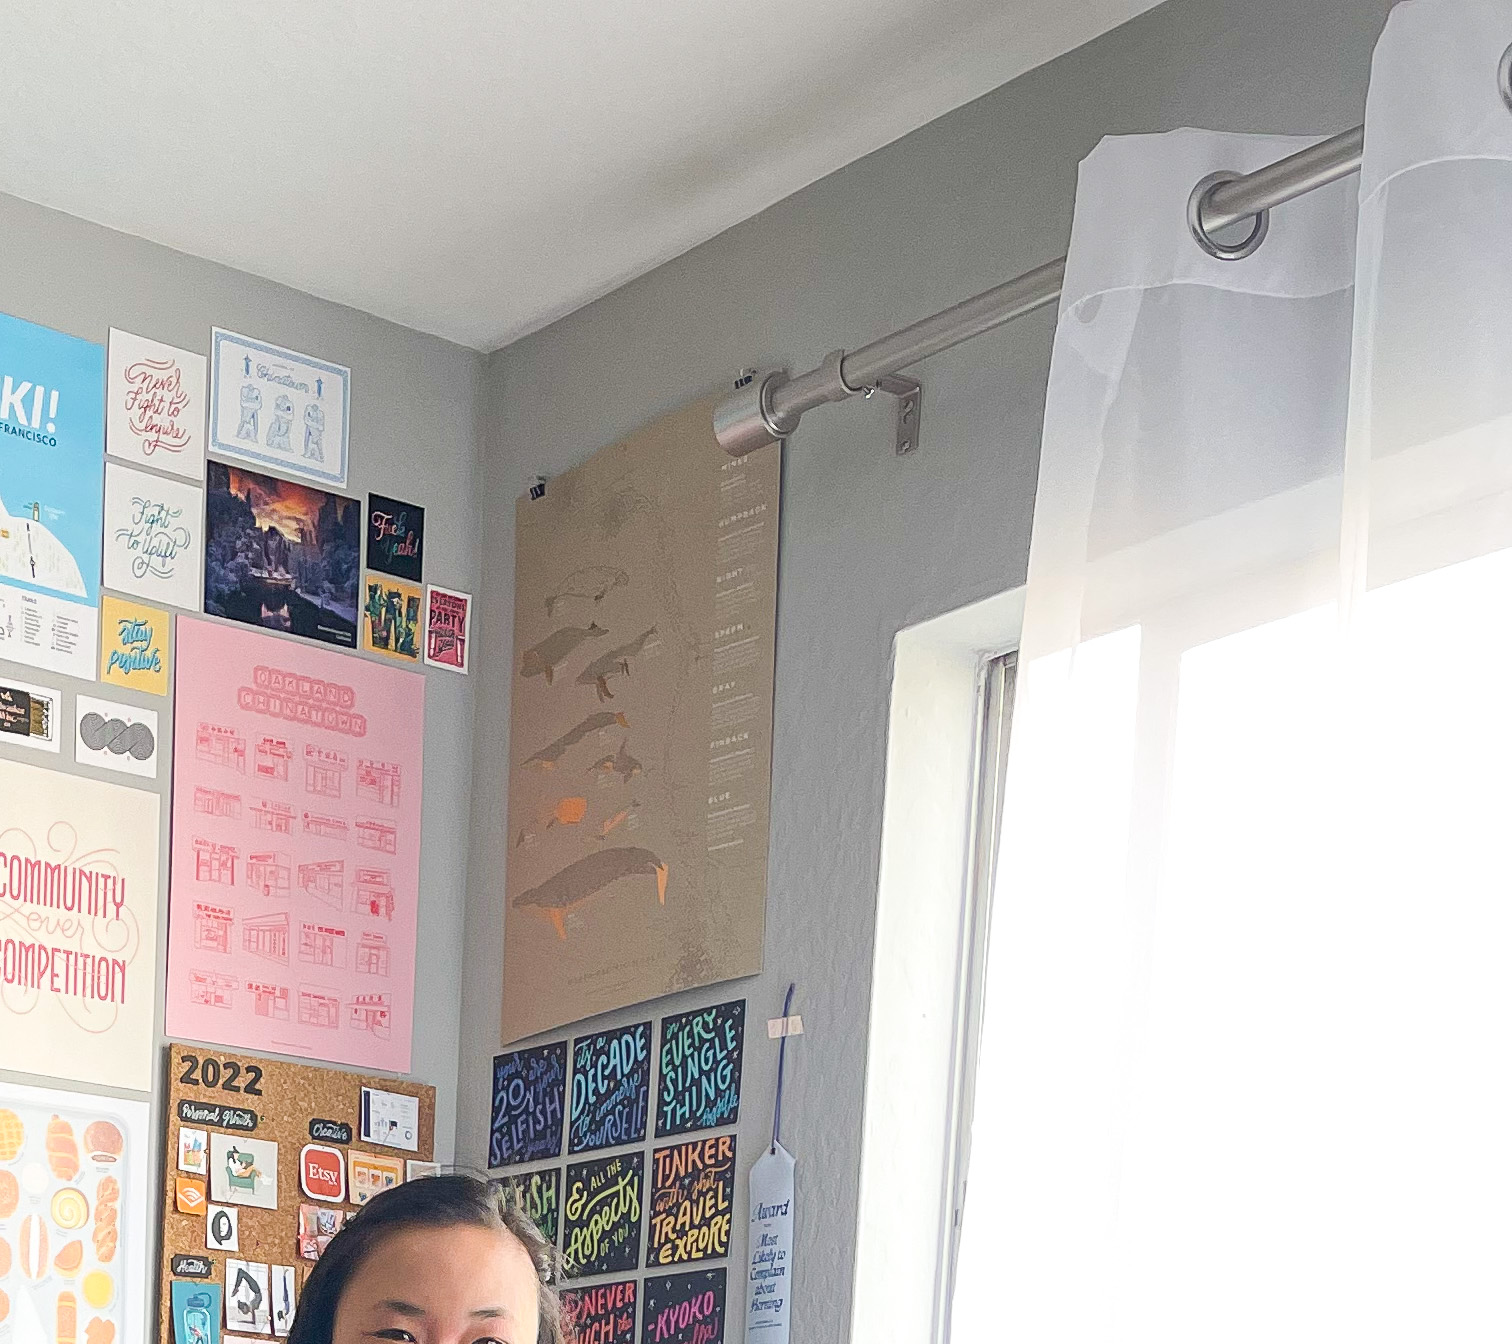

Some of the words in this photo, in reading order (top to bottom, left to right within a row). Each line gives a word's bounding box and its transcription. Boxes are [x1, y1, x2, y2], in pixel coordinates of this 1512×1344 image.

[430, 609, 466, 633] PARTY
[256, 668, 353, 705] OAKLAND
[241, 690, 364, 734] CHINATOWN
[661, 1008, 717, 1075] EVERY
[663, 1018, 737, 1102] SINGLE
[179, 1054, 264, 1097] 2022
[571, 1024, 648, 1122] DECADE
[662, 1059, 734, 1130] THING
[490, 1085, 562, 1166] SELFISH
[307, 1162, 339, 1186] Etsy
[590, 1171, 607, 1192] ALL
[606, 1158, 622, 1179] THE
[654, 1135, 734, 1189] TINKER
[651, 1180, 730, 1249] TRAVEL
[751, 1198, 791, 1223] Award
[600, 1238, 610, 1257] OF
[611, 1223, 630, 1247] YOU
[659, 1212, 732, 1265] EXPLORE
